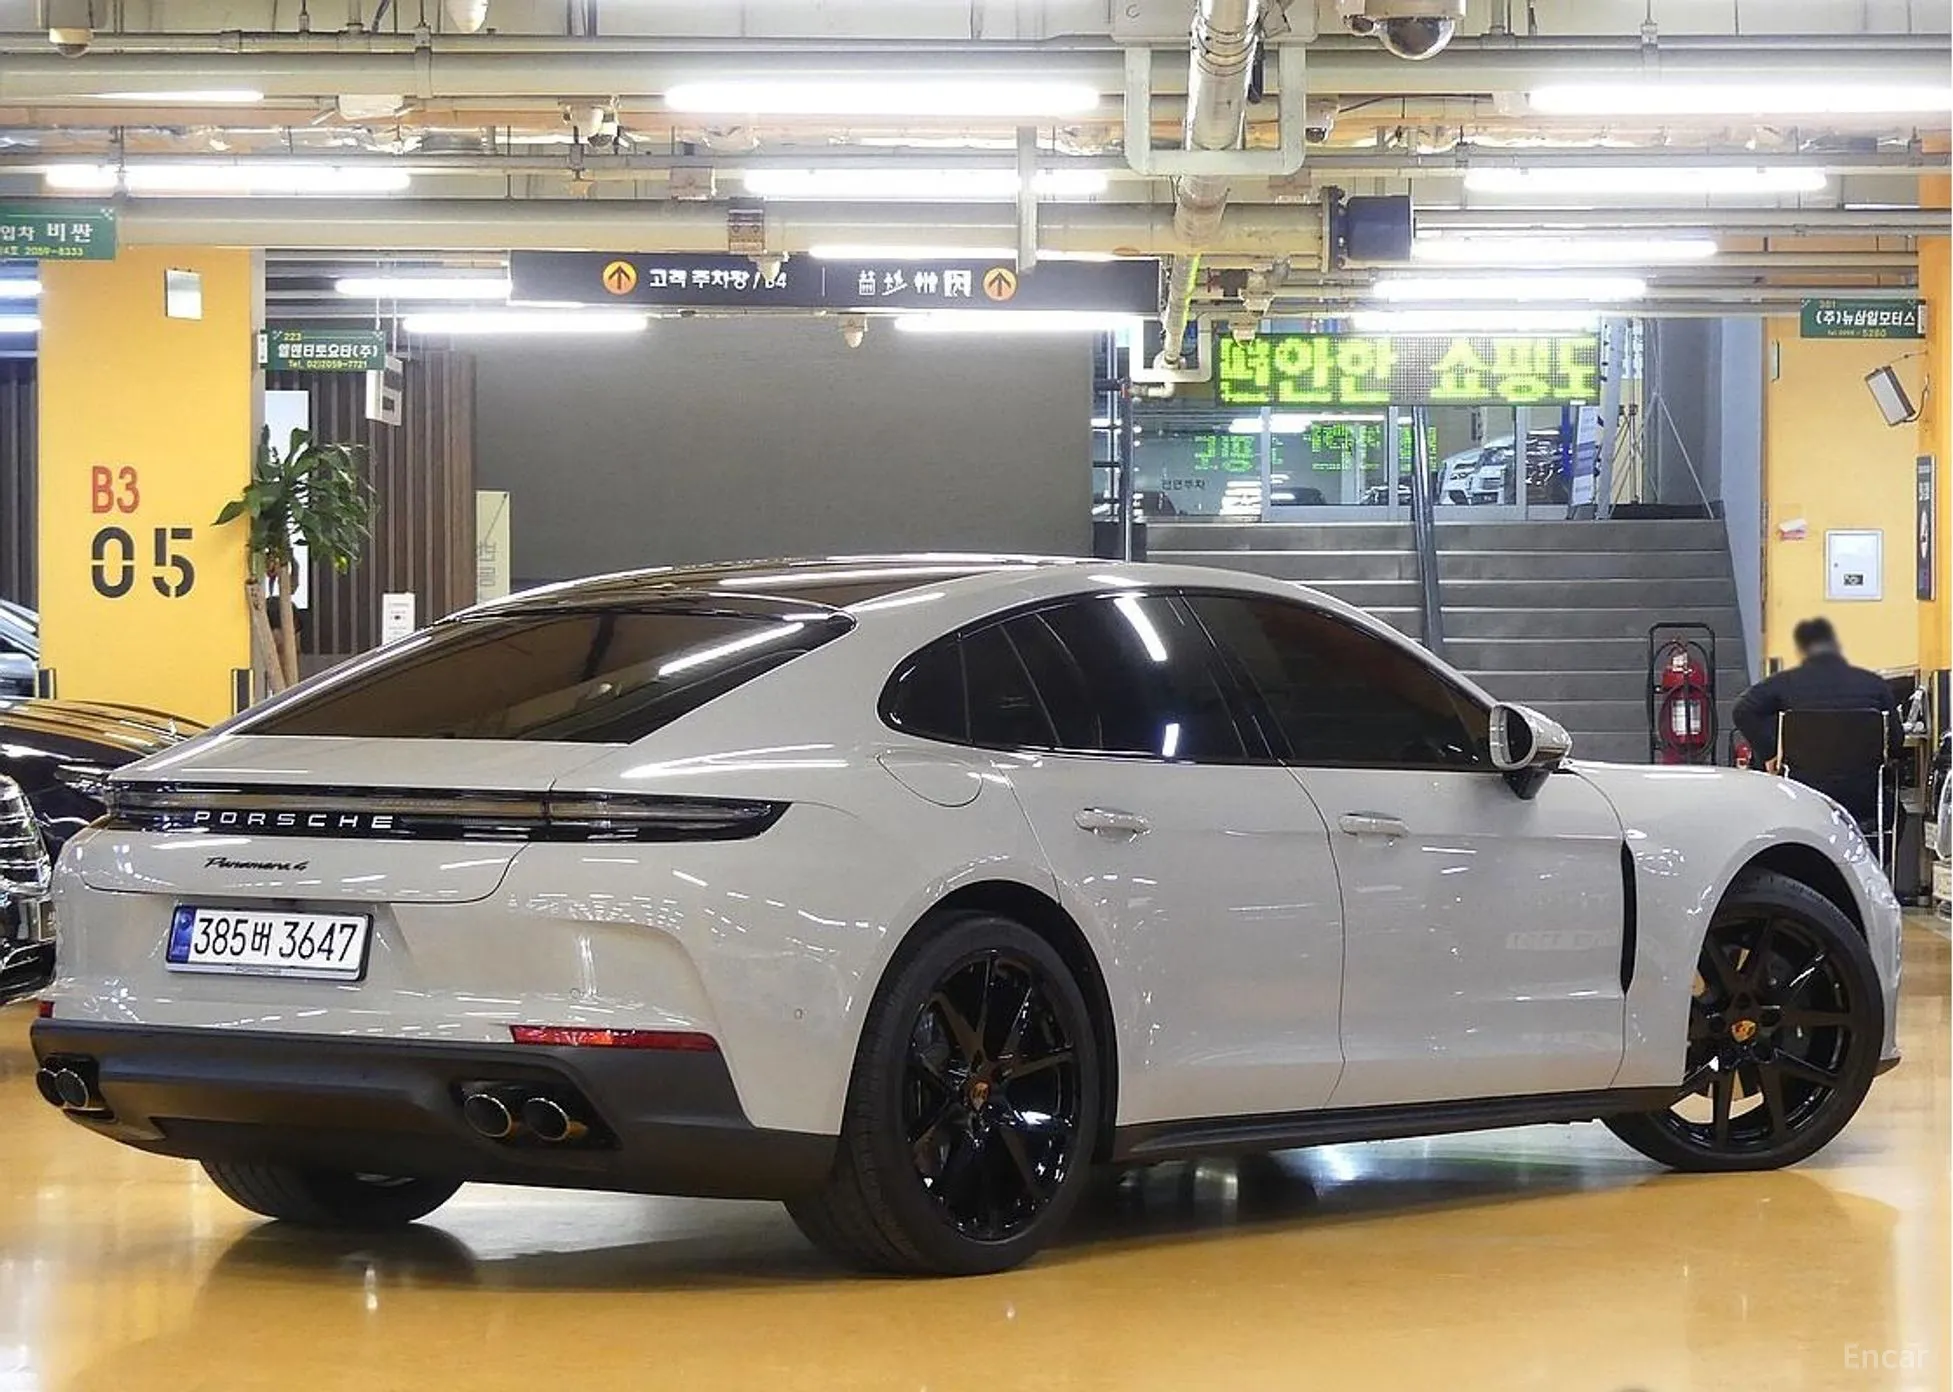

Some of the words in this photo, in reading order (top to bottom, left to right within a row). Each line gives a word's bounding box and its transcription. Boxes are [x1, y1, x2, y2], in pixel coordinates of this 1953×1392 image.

[650, 269, 688, 288] 고객
[692, 269, 749, 289] 주차장
[92, 465, 140, 514] B3
[91, 526, 195, 599] 05
[193, 811, 394, 829] PORSCHE
[204, 857, 291, 871] Panamera
[193, 917, 273, 957] 385버
[278, 921, 358, 963] 3647
